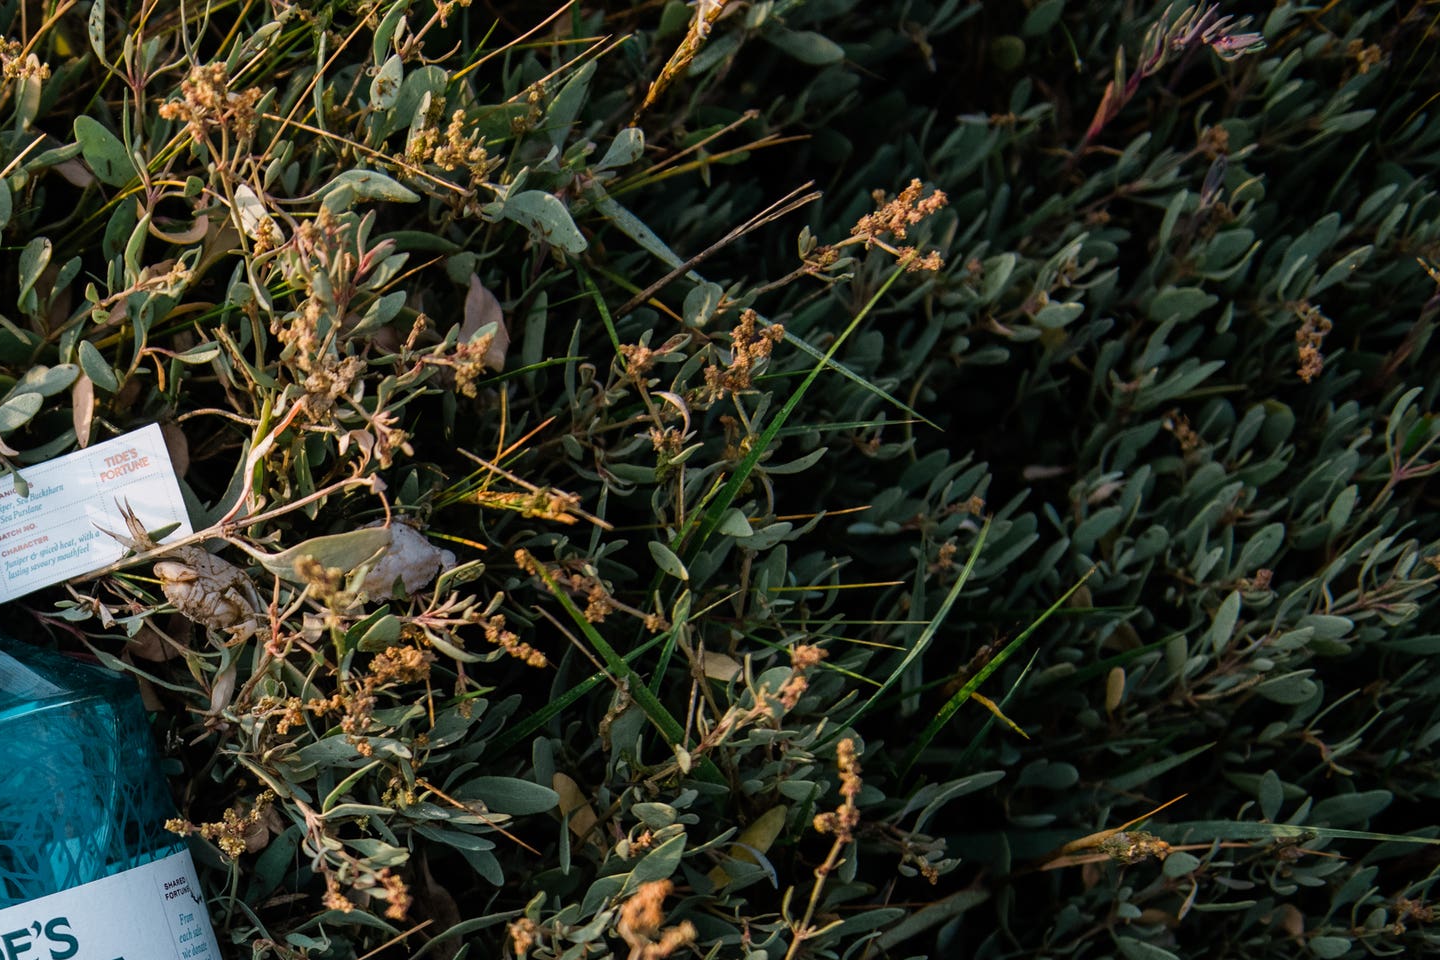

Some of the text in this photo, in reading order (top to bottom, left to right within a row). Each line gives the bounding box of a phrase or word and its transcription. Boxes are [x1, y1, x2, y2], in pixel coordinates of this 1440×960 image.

[103, 448, 138, 468] TIDE'S
[100, 456, 150, 482] FORTUNE
[29, 483, 64, 502] Buckthorn
[0, 513, 13, 525] Sea
[13, 503, 43, 519] Purslane
[1, 535, 49, 558] CHARACTER
[4, 556, 29, 571] Juniper
[40, 542, 59, 558] spiced
[59, 538, 77, 550] heat,
[78, 530, 94, 543] with
[8, 543, 90, 580] lasting savoury mouthfeel
[164, 876, 186, 891] SHARED
[179, 913, 194, 926] From
[179, 924, 203, 944] each sale
[182, 942, 208, 960] we donate
